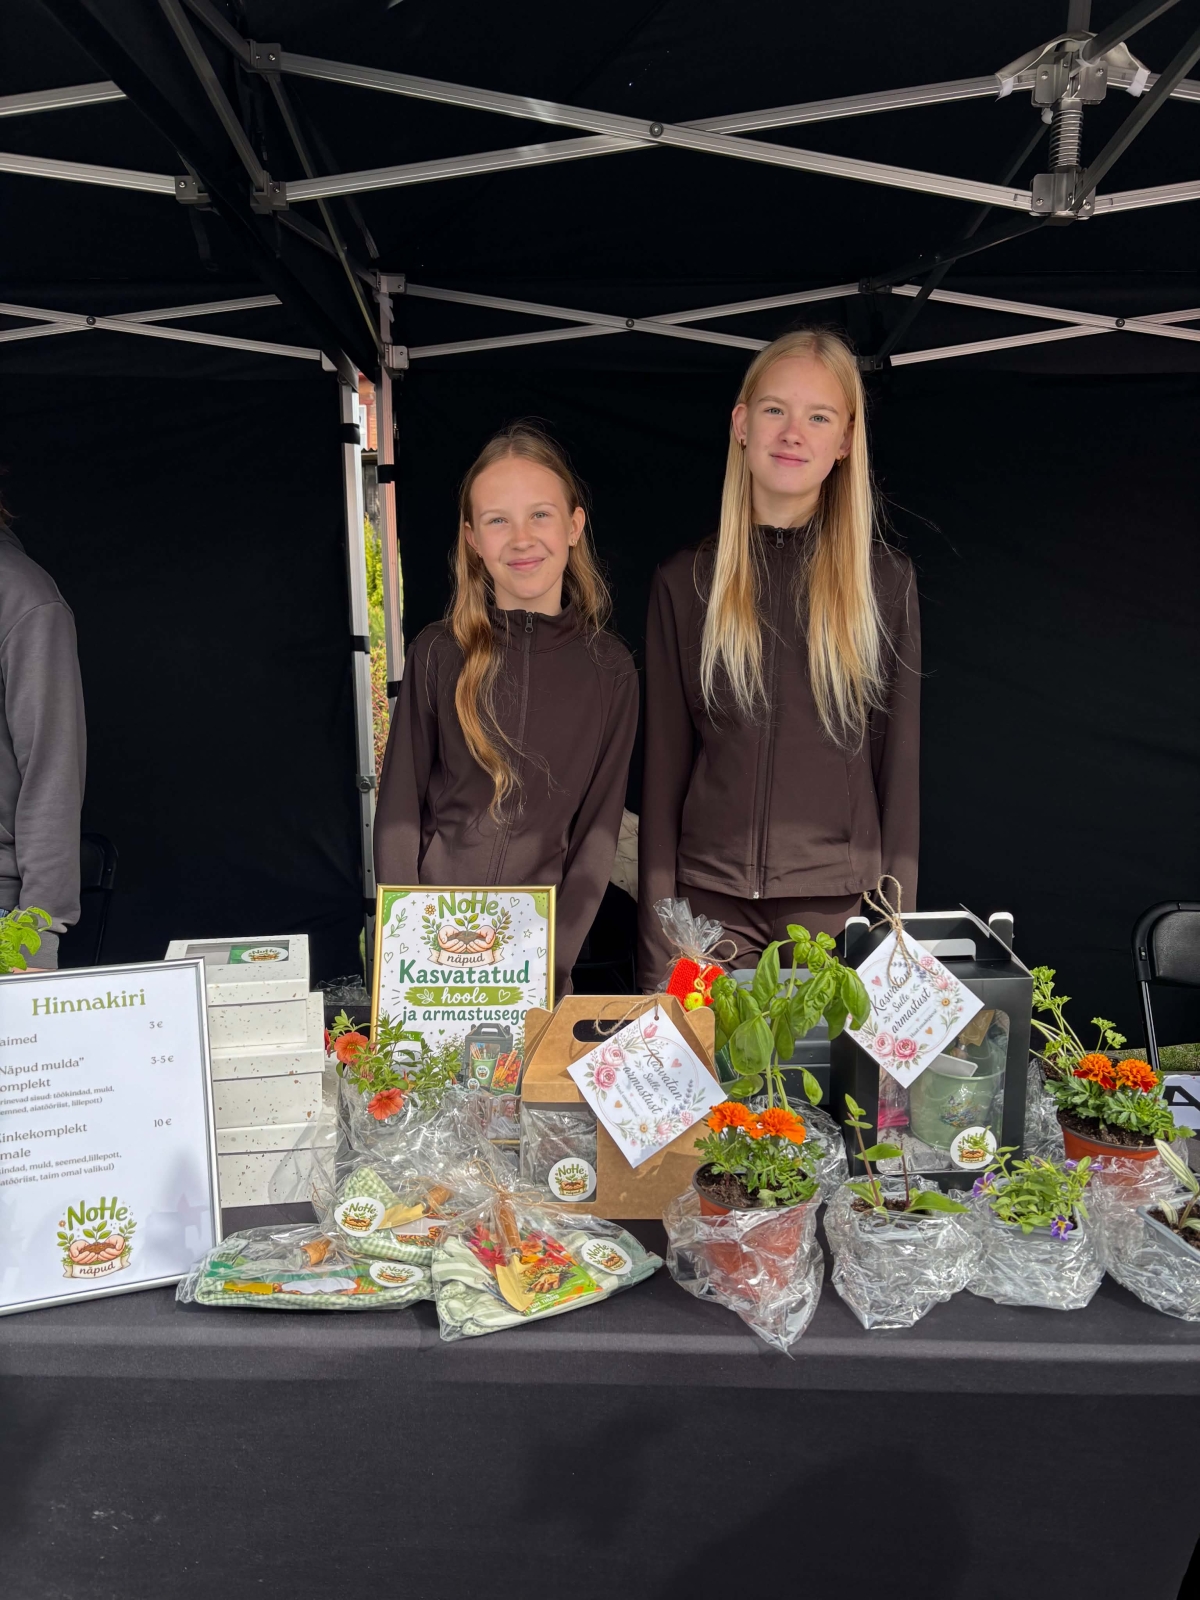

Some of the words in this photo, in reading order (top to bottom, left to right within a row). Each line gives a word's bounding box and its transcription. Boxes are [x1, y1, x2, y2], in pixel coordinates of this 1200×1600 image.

[438, 891, 499, 919] NoHe
[446, 953, 486, 966] näpud
[399, 959, 530, 984] Kasvatatud
[32, 988, 146, 1016] Hinnakiri
[441, 987, 488, 1004] hoole
[870, 970, 912, 1017] Kasvatan
[891, 987, 932, 1034] armastust
[892, 993, 911, 1013] Sulle
[402, 1006, 417, 1025] ja
[149, 1021, 156, 1029] 3
[157, 1021, 163, 1029] €
[151, 1055, 166, 1064] 3-5
[167, 1055, 174, 1063] €
[623, 1066, 664, 1114] armastust
[643, 1073, 659, 1092] Sulle
[154, 1119, 164, 1128] 10
[165, 1118, 172, 1126] €
[30, 1160, 54, 1170] muld,
[40, 1172, 60, 1180] taim
[61, 1168, 82, 1177] omal
[83, 1162, 115, 1174] valikul)
[557, 1163, 585, 1177] NoHe
[67, 1196, 128, 1231] NoHe
[349, 1202, 376, 1214] NoHe
[586, 1243, 608, 1259] NoHe
[79, 1262, 115, 1277] näpud
[385, 1265, 414, 1275] NoHe
